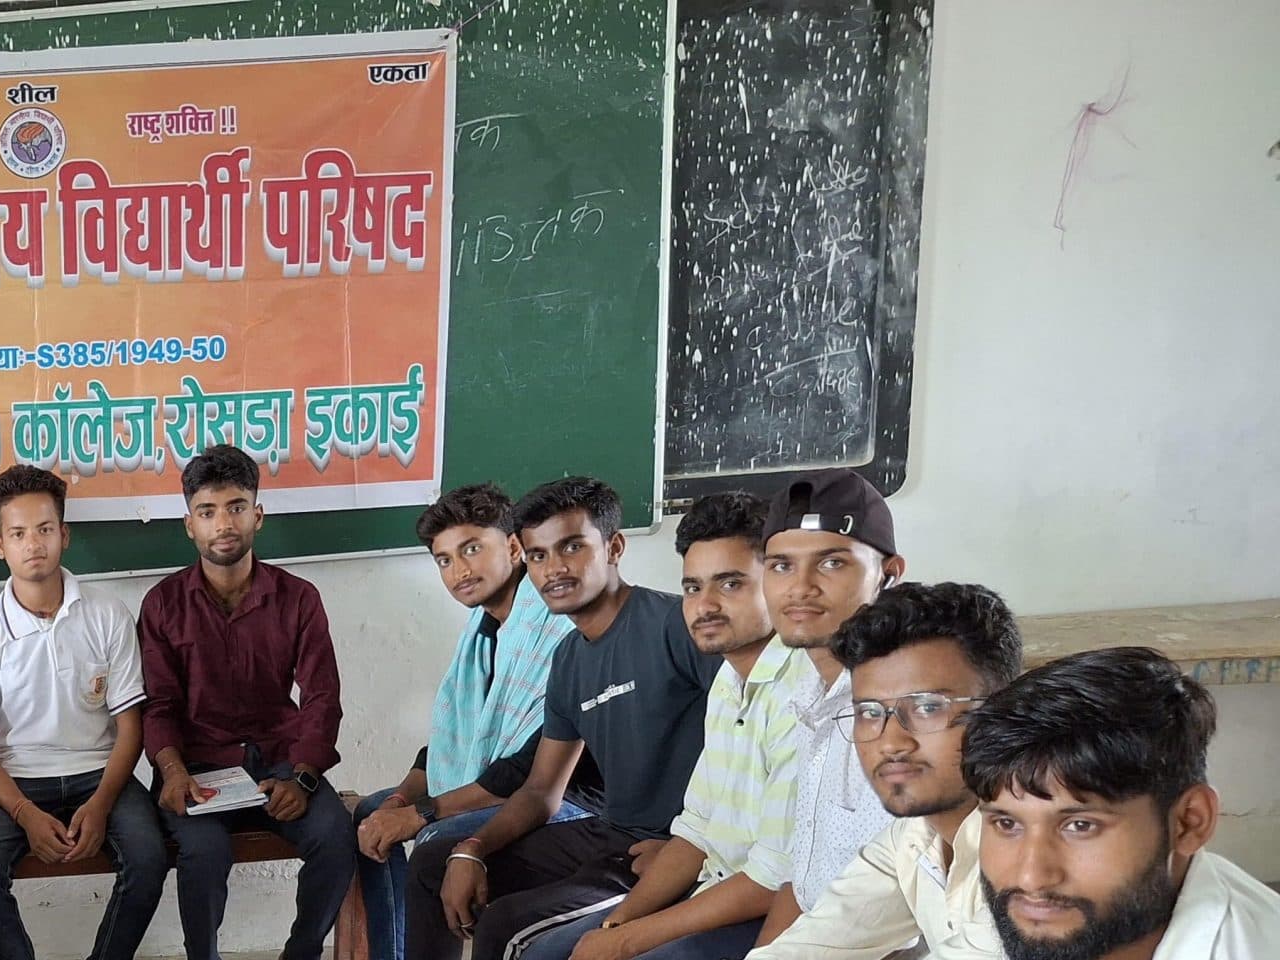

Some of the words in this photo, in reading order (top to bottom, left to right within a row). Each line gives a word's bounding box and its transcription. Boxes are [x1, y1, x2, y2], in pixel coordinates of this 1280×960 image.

[367, 62, 430, 84] एकता
[7, 82, 58, 105] शील
[126, 112, 162, 143] राष्ट्र
[164, 104, 215, 135] शक्ति
[57, 147, 251, 287] विद्यार्थी
[261, 148, 433, 278] परिषद
[305, 364, 425, 472] इकाई
